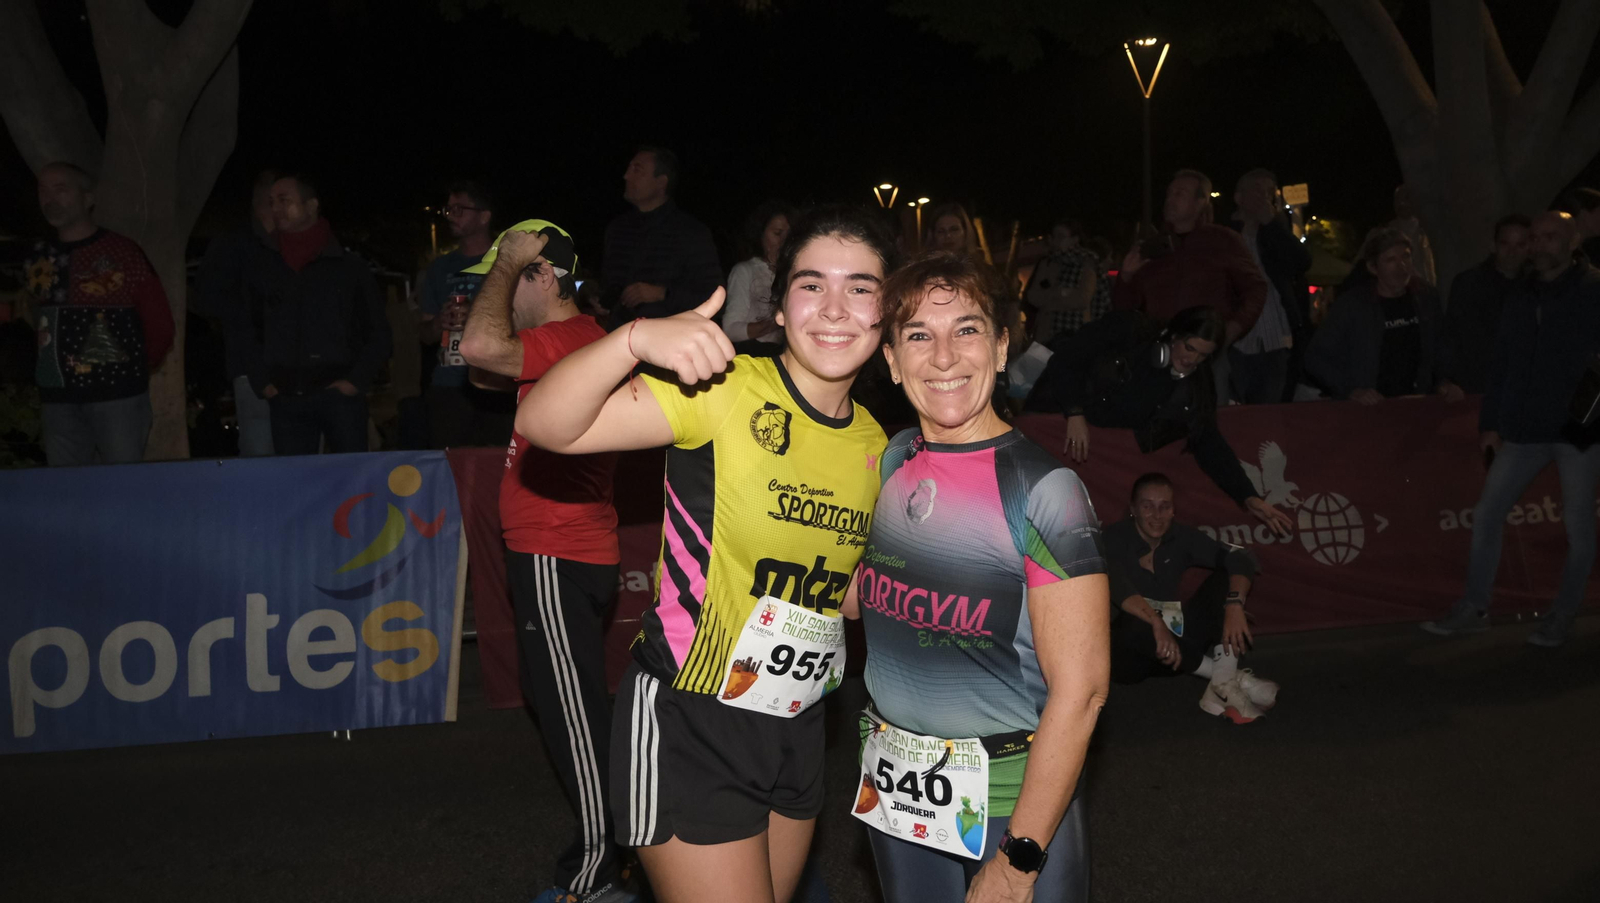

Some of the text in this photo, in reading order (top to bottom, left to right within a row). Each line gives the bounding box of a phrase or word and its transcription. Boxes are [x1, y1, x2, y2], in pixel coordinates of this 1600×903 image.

[768, 478, 835, 498] Centro Deportivo
[777, 493, 871, 536] SPORTGYM
[836, 534, 847, 546] El
[866, 544, 906, 569] Deportivo
[786, 608, 807, 625] XIV
[807, 616, 830, 632] SAN
[782, 622, 821, 643] CIUDAD
[917, 631, 934, 648] El
[8, 592, 440, 738] portes
[766, 644, 836, 681] 955
[879, 735, 906, 760] CIUDAD
[908, 750, 923, 764] DE
[891, 730, 909, 748] SAN
[911, 738, 978, 753] SILVETRE
[876, 757, 953, 806] 540
[890, 800, 936, 820] JORQUERA
